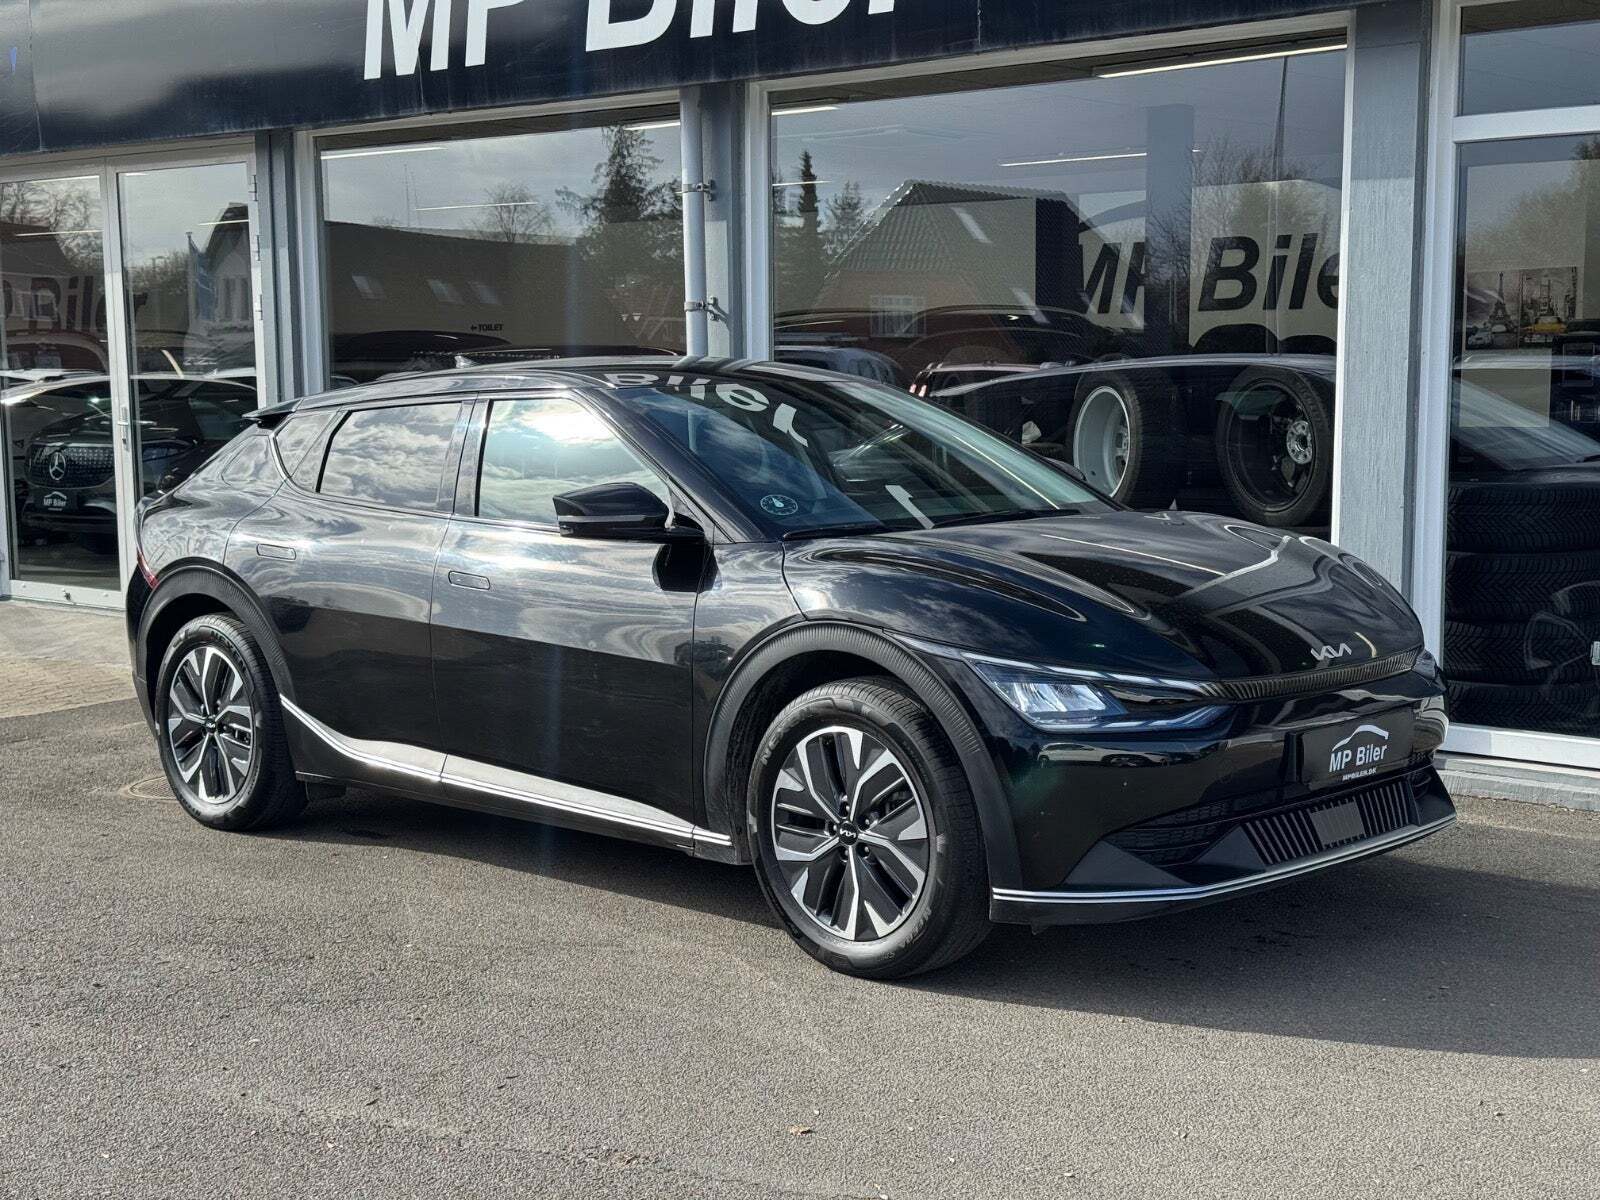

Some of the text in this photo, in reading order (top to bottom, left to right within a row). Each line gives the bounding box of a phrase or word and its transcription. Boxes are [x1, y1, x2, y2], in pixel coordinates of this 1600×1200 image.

[479, 323, 504, 332] TOILET
[1329, 743, 1388, 773] MP Biler
